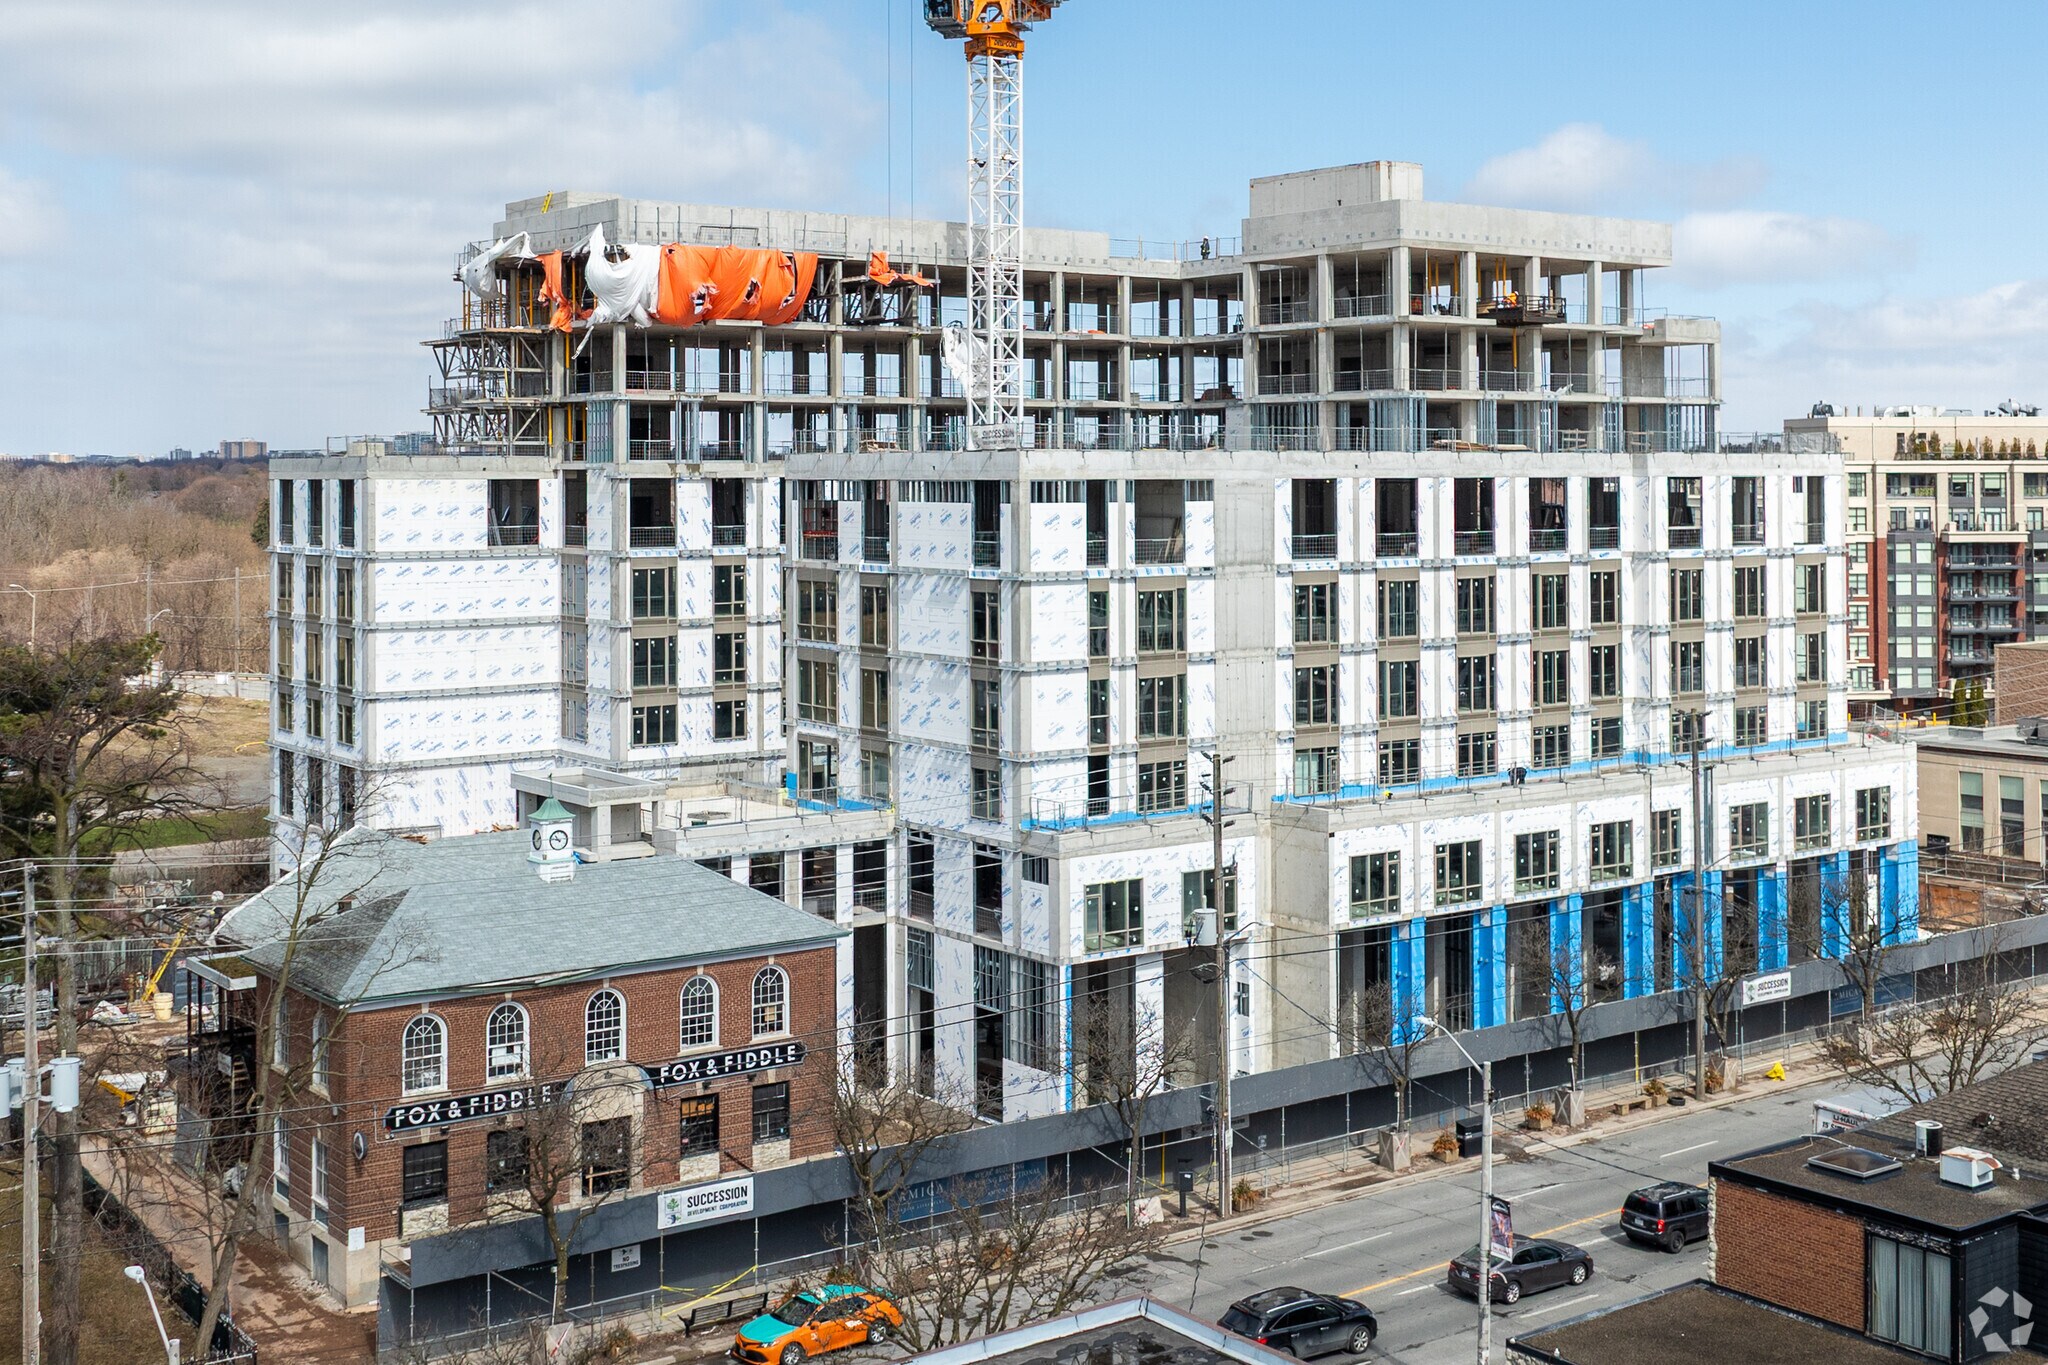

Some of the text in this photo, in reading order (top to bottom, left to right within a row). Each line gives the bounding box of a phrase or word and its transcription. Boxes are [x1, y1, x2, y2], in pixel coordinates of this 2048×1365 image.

[660, 1045, 796, 1083] FOX & FIDDLE
[394, 1085, 551, 1128] FOX & FIDDLE
[687, 1185, 748, 1208] SUCCESSION
[687, 1200, 748, 1217] DEVELOPMENT CORPORATION
